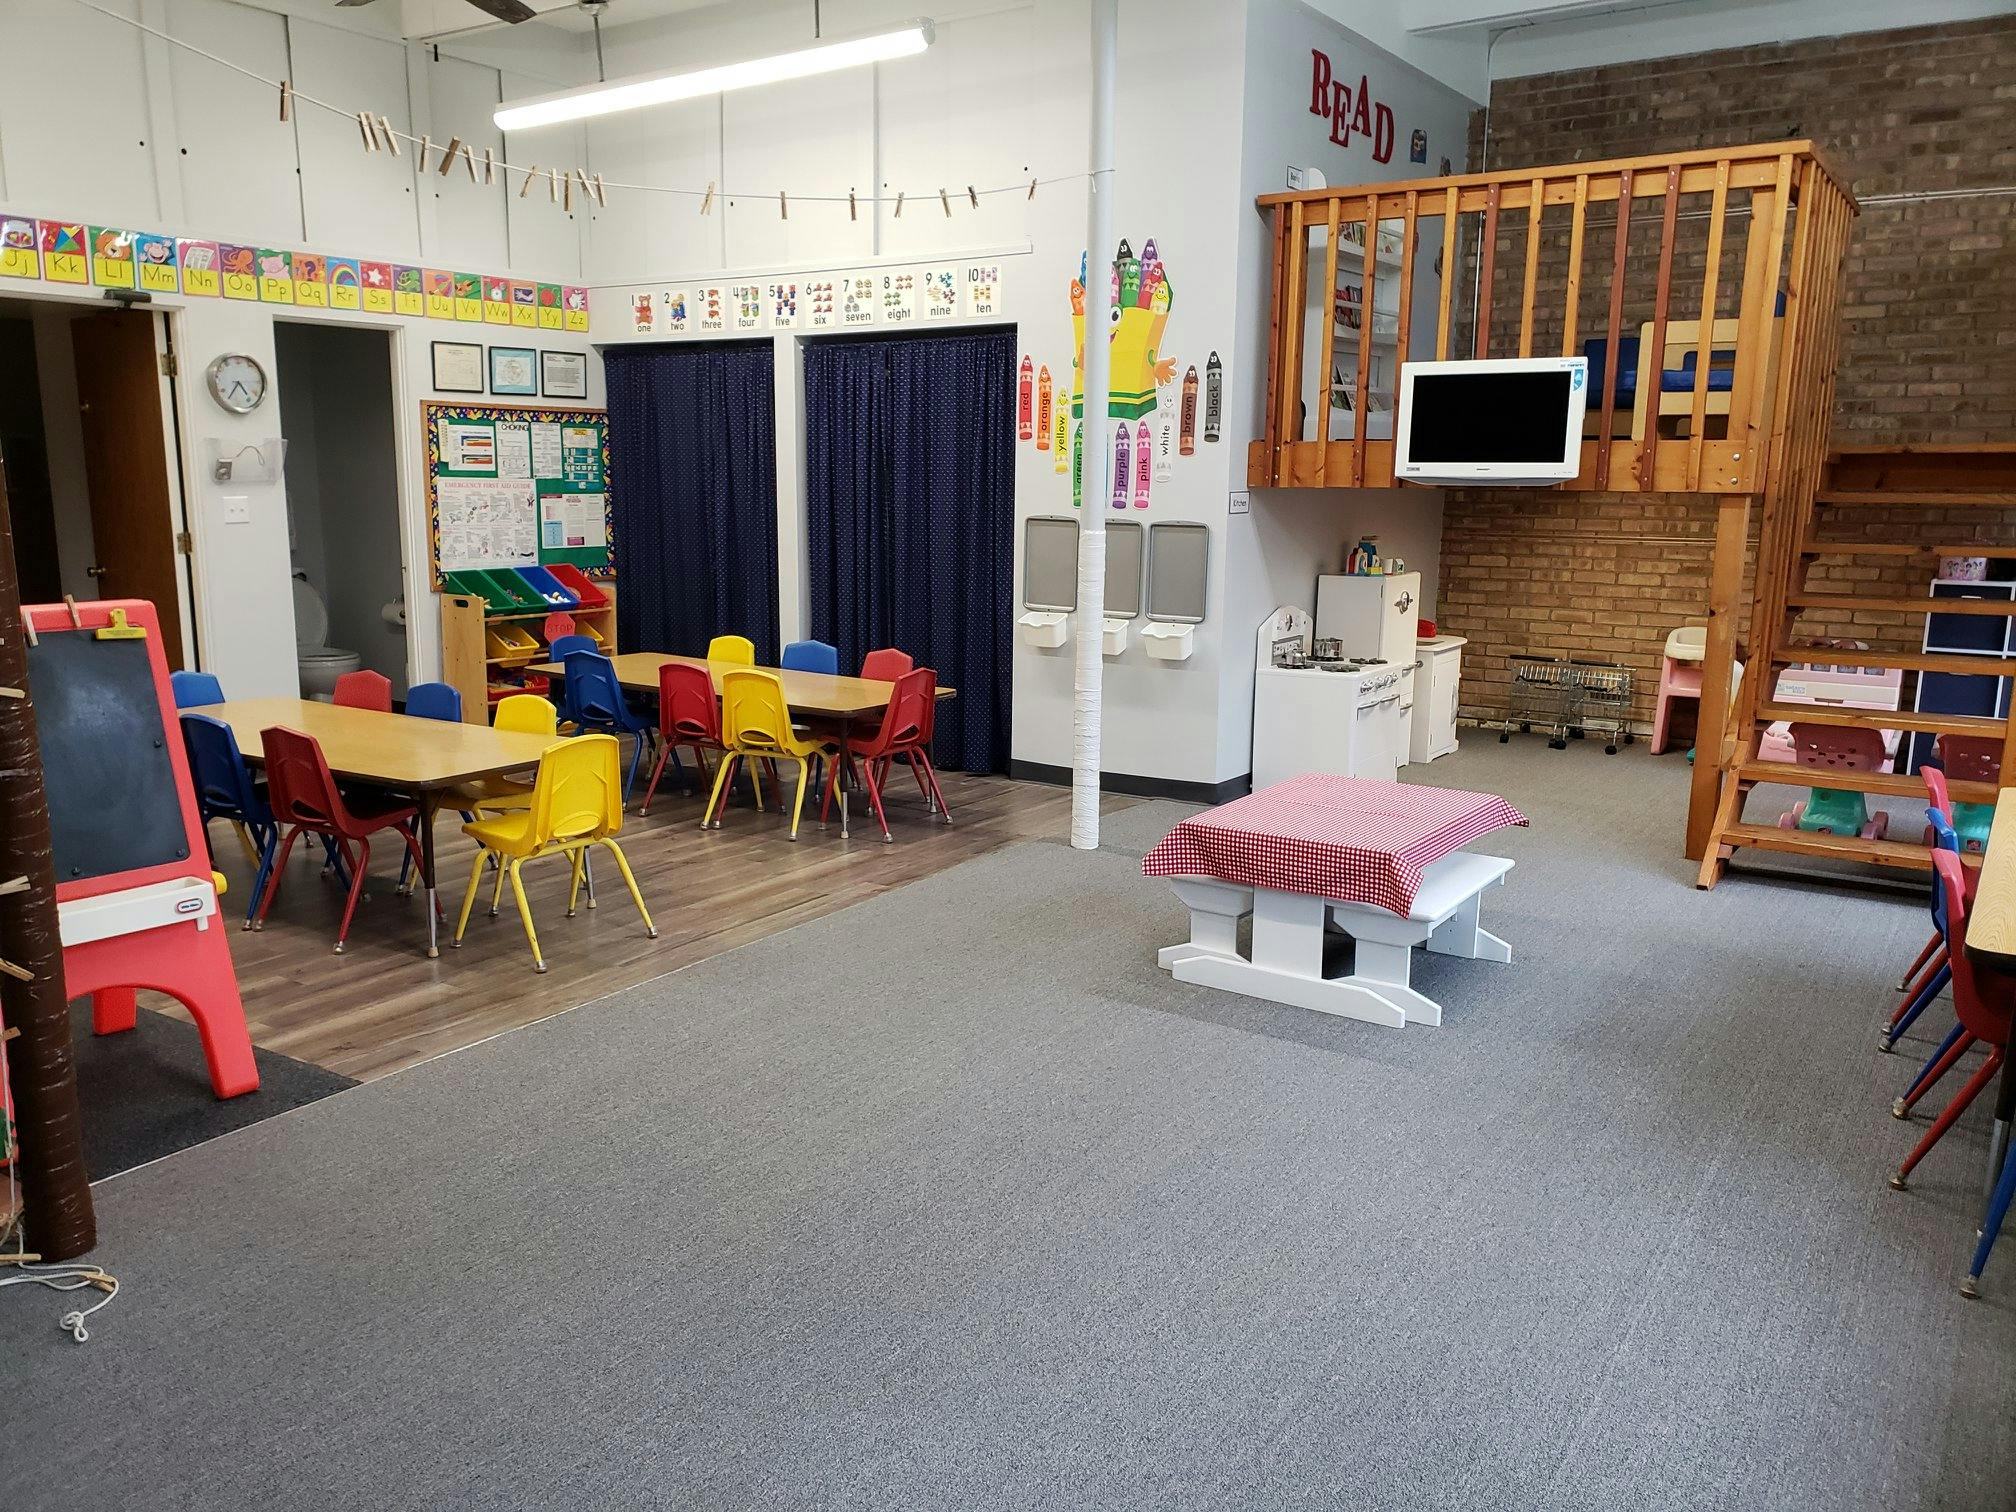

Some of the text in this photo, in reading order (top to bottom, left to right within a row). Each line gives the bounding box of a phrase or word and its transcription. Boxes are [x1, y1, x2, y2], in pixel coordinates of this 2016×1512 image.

[1309, 48, 1395, 164] READ
[926, 272, 932, 285] 9
[968, 268, 979, 282] 10
[843, 280, 849, 292] 7
[884, 276, 890, 289] 8
[733, 288, 739, 298] 4
[769, 286, 775, 297] 5
[806, 283, 812, 295] 6
[664, 293, 670, 304] 2
[698, 290, 704, 302] 3
[930, 306, 951, 316] nine
[976, 304, 992, 312] ten
[814, 316, 826, 324] six
[846, 312, 871, 322] seven
[888, 309, 911, 320] eight
[738, 318, 755, 327] four
[776, 317, 790, 326] five
[1208, 385, 1219, 416] black
[1042, 392, 1050, 430] orange
[1182, 396, 1193, 432] brown
[1056, 416, 1066, 452] yellow
[1161, 425, 1170, 456] white
[1117, 452, 1128, 487] purple
[1139, 458, 1149, 481] pink
